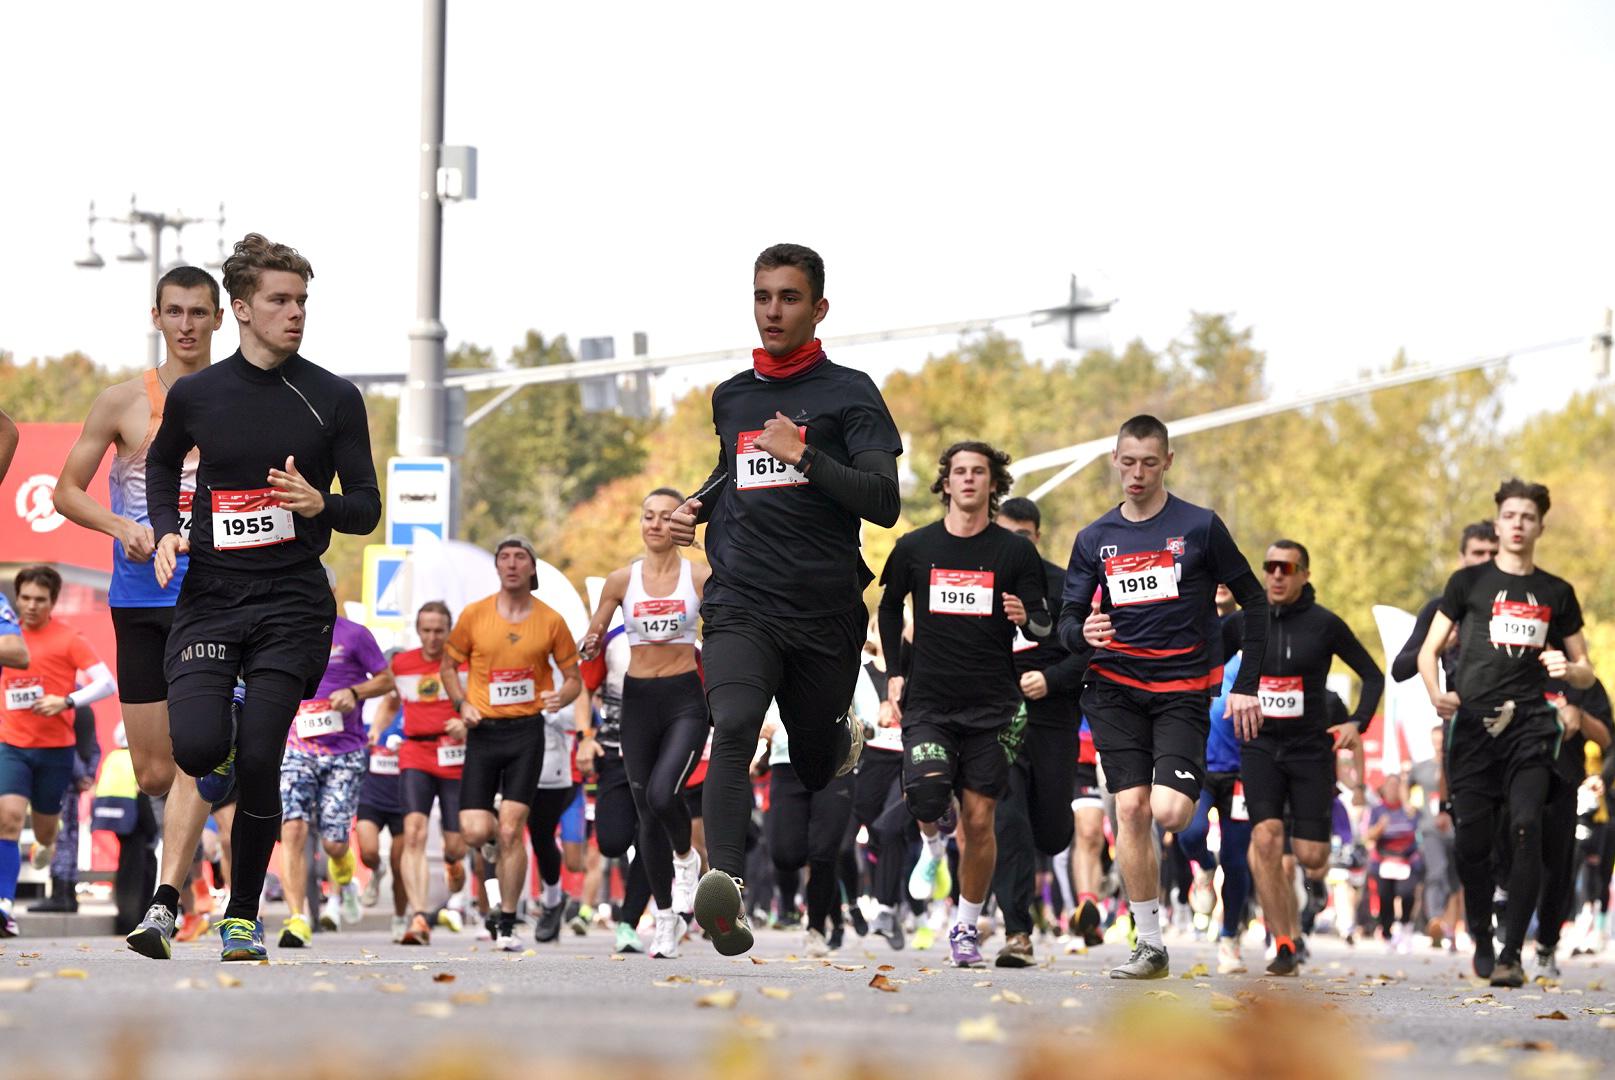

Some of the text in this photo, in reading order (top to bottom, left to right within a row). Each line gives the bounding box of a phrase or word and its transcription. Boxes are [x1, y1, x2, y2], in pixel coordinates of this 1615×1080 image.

[748, 457, 787, 475] 1613
[222, 515, 274, 536] 1955
[1119, 575, 1158, 593] 1918
[941, 591, 976, 605] 1916
[642, 619, 679, 632] 1475
[1505, 623, 1536, 637] 1919
[181, 643, 226, 662] MOOD
[497, 685, 527, 697] 1755
[1262, 696, 1296, 708] 1709
[303, 715, 332, 728] 1836
